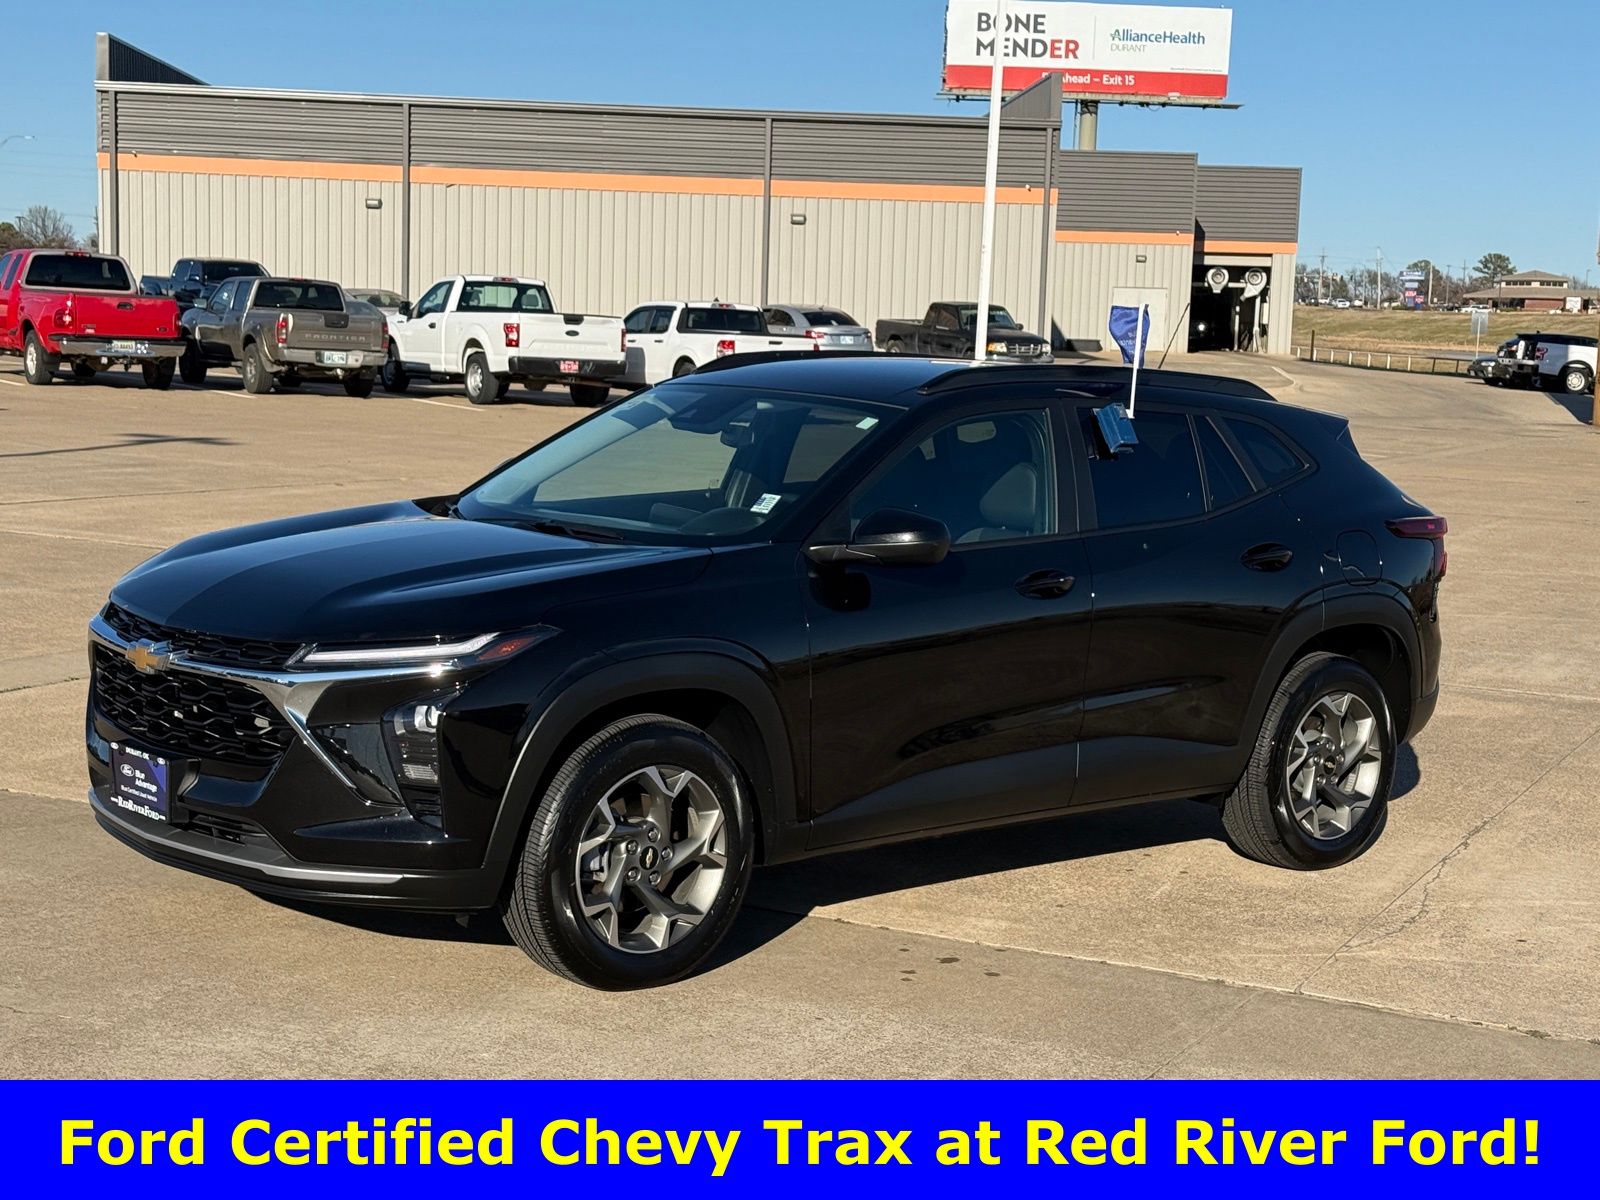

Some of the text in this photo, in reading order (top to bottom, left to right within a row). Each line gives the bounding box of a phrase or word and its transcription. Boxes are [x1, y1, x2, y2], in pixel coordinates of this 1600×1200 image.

[977, 12, 1046, 34] BONE
[1110, 29, 1206, 45] AllianceHealth
[976, 37, 1080, 59] MENDER
[1110, 43, 1146, 52] DURANT
[1062, 72, 1091, 84] head
[1102, 74, 1123, 86] Exit
[1125, 74, 1135, 86] 15
